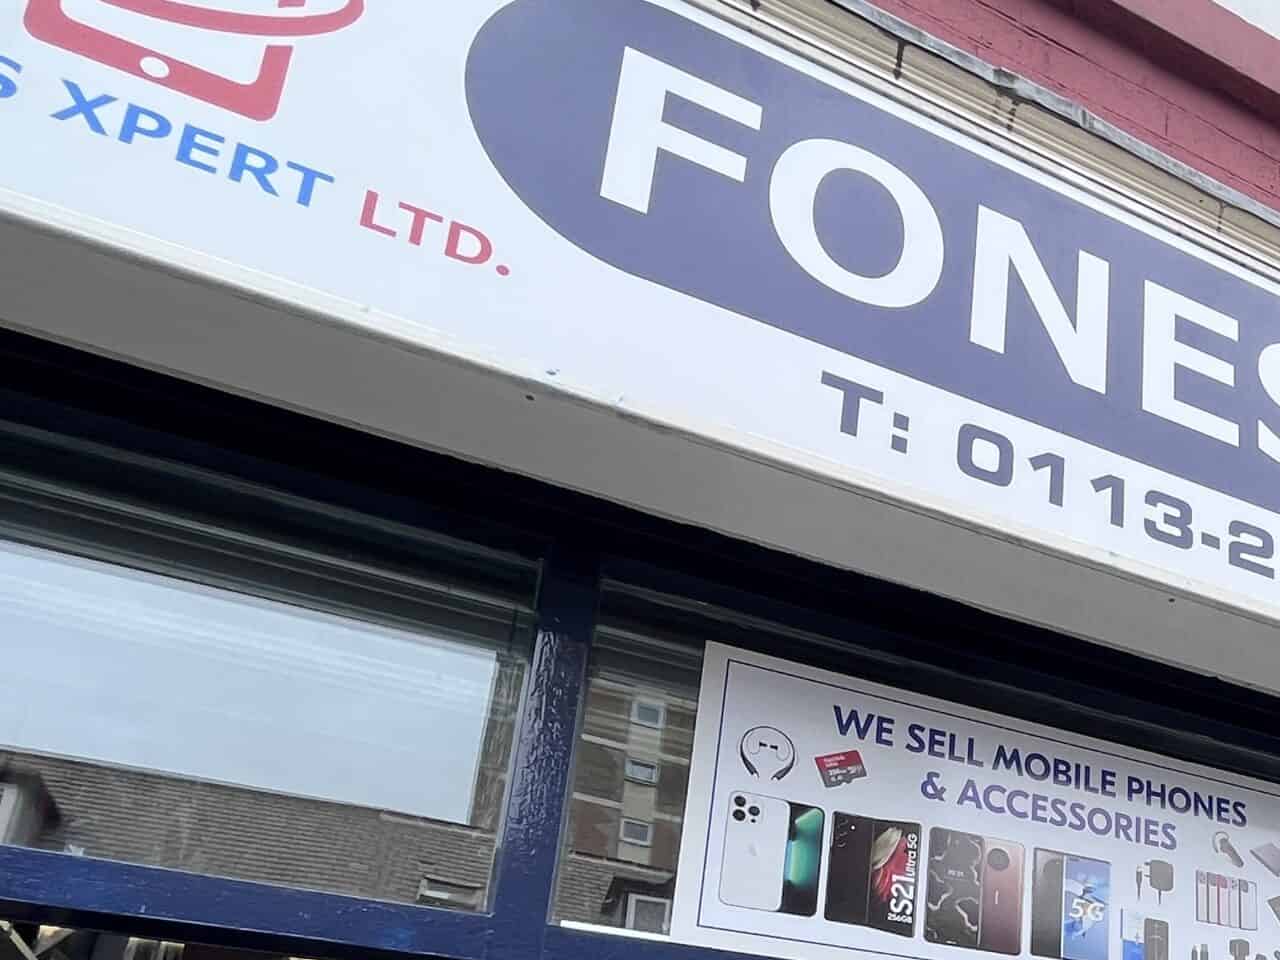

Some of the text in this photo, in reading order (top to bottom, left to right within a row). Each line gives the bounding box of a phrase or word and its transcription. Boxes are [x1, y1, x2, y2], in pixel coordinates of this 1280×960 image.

[49, 78, 511, 277] XPERT LTD.
[820, 370, 909, 454] T:
[833, 704, 1248, 828] WE SELL MOBILE PHONES
[920, 771, 1177, 850] & ACCESSORIES
[890, 874, 915, 915] S21
[1069, 898, 1106, 922] 5G
